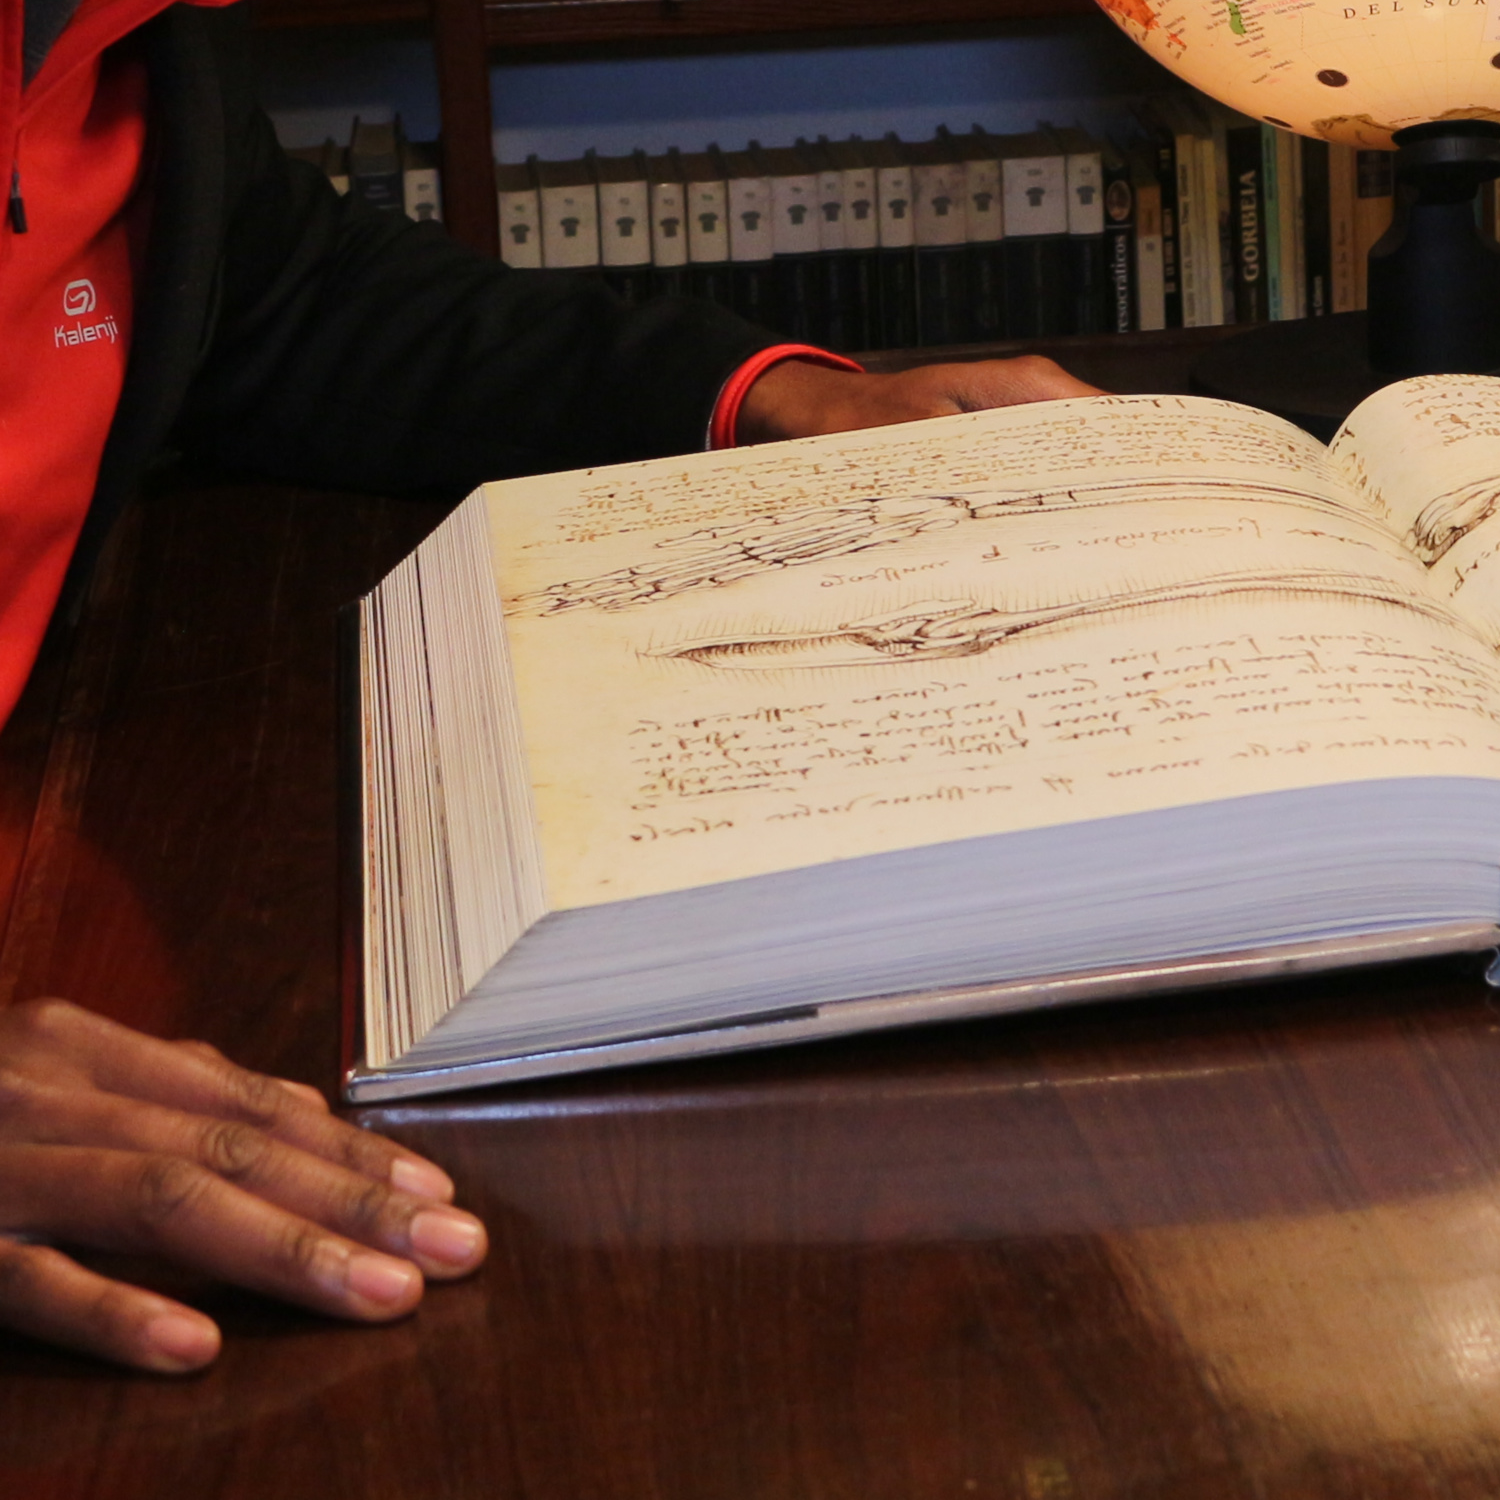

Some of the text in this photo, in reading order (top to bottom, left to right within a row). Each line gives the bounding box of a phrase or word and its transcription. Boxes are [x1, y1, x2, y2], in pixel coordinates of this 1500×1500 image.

[1342, 0, 1405, 20] DEL
[1239, 169, 1260, 283] GORBEIA
[1109, 235, 1130, 334] resocráticos
[53, 315, 119, 349] Kalenji
